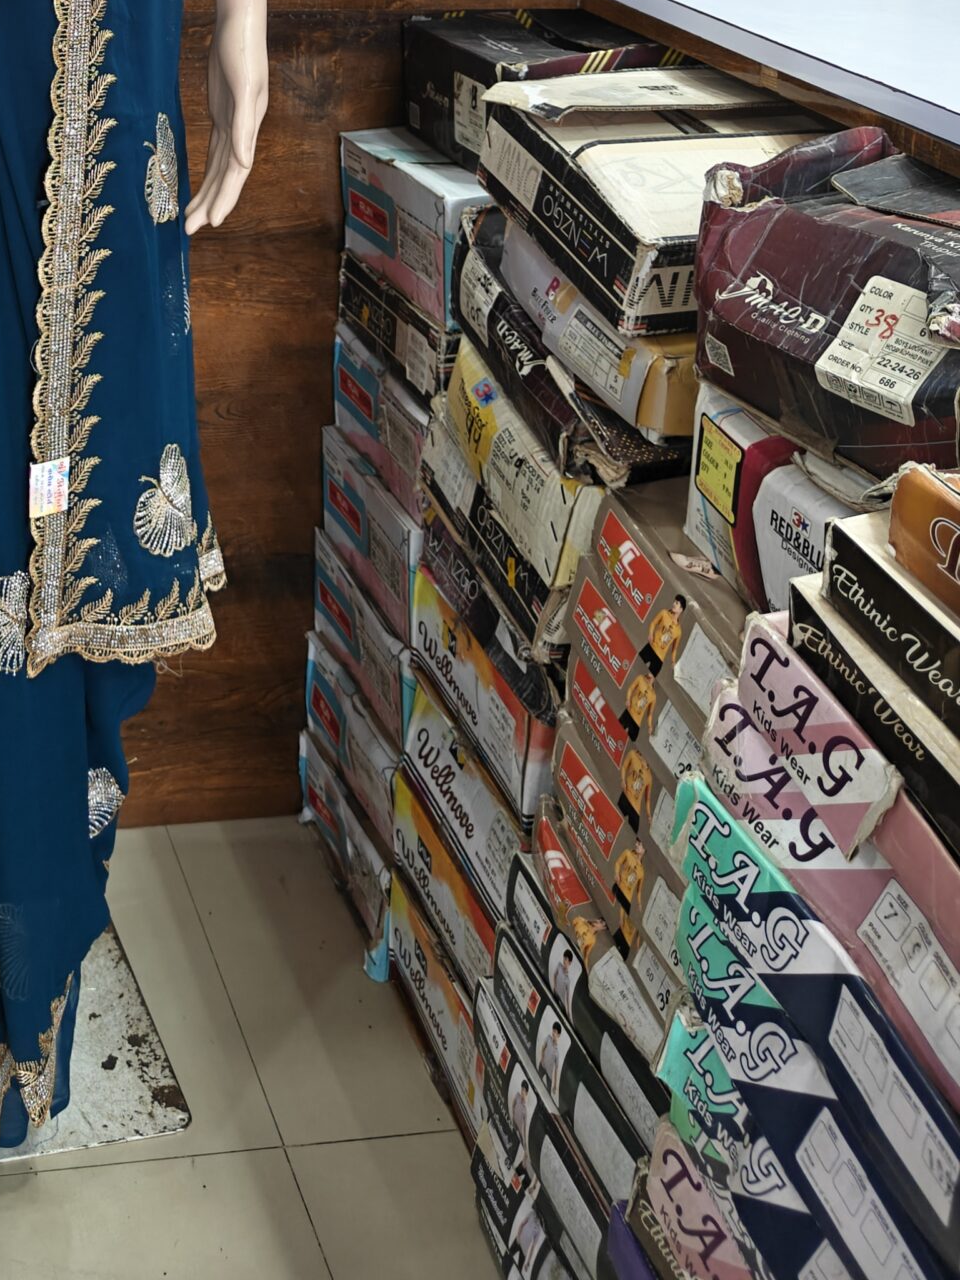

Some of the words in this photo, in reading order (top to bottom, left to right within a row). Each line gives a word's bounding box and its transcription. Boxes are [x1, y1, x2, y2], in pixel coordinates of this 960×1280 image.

[892, 222, 945, 243] Karunya
[859, 303, 874, 316] QTY
[869, 285, 894, 300] COLOR
[778, 324, 811, 344] Clothing
[848, 322, 870, 337] STYLE
[828, 353, 849, 367] ORDER
[878, 376, 896, 390] 686
[876, 357, 922, 381] 22-24-26
[770, 508, 825, 572] RED&BLU
[832, 564, 899, 642] Ethinic
[418, 620, 478, 727] Wellmove
[793, 622, 866, 696] Ethinic
[867, 685, 925, 761] Wear
[753, 699, 777, 743] Kids
[780, 737, 811, 786] Wear
[417, 727, 474, 840] Wellmove
[712, 764, 739, 806] Kids
[741, 802, 780, 850] Wear
[396, 827, 456, 947] Wellmove
[692, 861, 720, 911] Kids
[723, 904, 758, 958] Wear
[394, 927, 448, 1053] Wellmove
[706, 1005, 737, 1063] Wear
[682, 1075, 714, 1128] Kids
